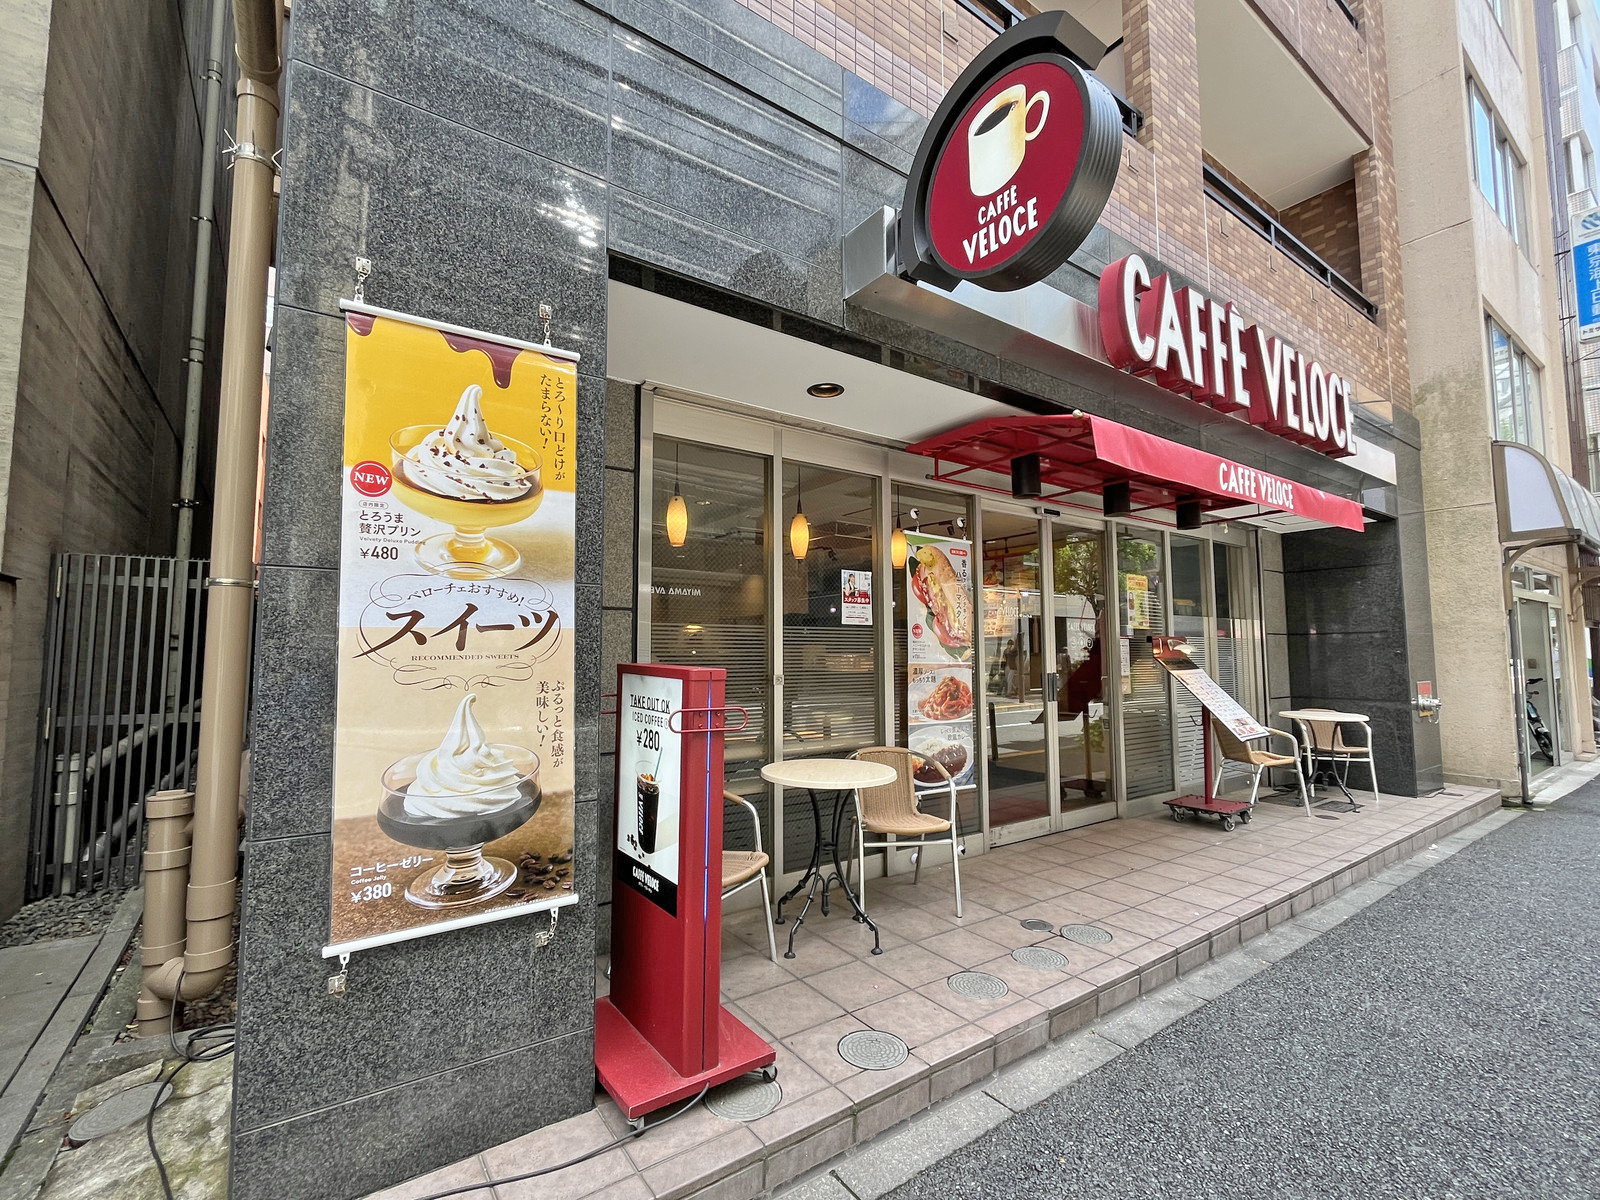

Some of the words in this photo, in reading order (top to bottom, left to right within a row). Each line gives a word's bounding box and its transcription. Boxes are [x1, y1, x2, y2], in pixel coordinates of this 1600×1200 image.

[962, 197, 1038, 264] VELOCE
[1256, 325, 1357, 456] VELOCE
[540, 373, 552, 449] たまらない!
[353, 471, 390, 486] NEW
[1258, 473, 1294, 510] VELOCE
[359, 510, 404, 523] とろうま
[359, 523, 421, 537] 贅沢プリン
[360, 545, 399, 560] ¥480
[407, 582, 525, 607] ベローチェおすすめ!
[352, 603, 560, 659] スイーツ
[411, 653, 484, 662] RECOMMENDED
[485, 653, 520, 661] SWEETS
[536, 681, 549, 747] 美味しい!
[630, 694, 646, 709] TAKE
[647, 697, 660, 711] OUT
[661, 699, 670, 713] OK
[551, 680, 565, 768] ぷるっと食感が
[632, 711, 643, 722] ICED
[645, 714, 664, 728] COFFEE
[636, 728, 660, 751] ¥280
[351, 856, 434, 877] コーヒーゼリー
[351, 882, 392, 903] ¥380
